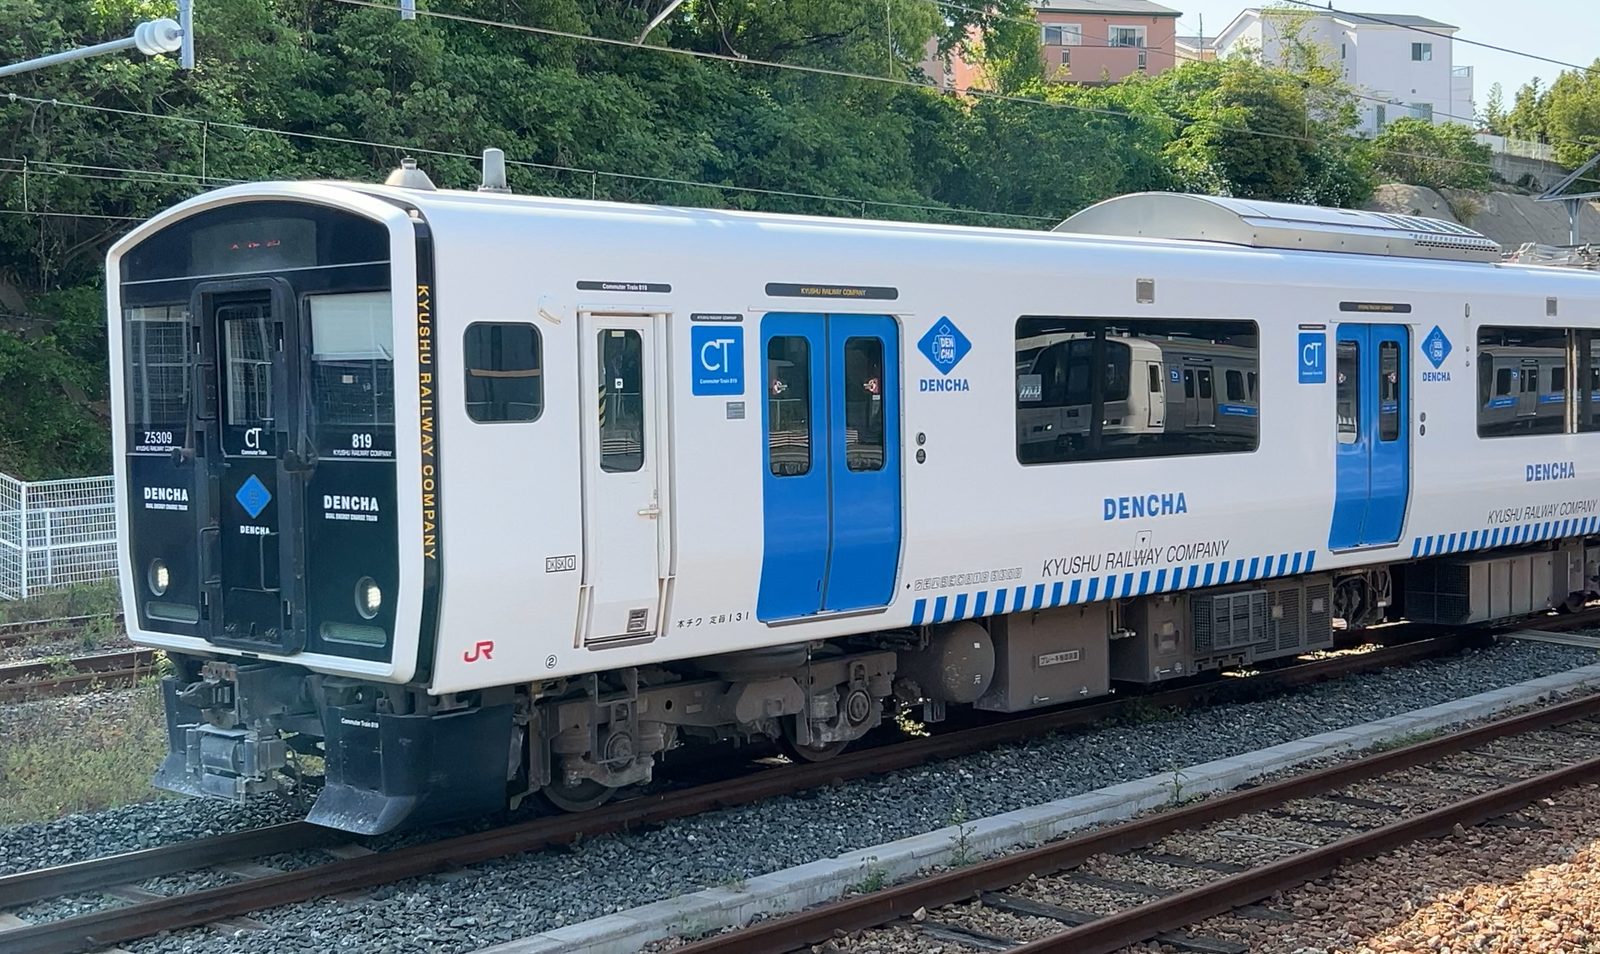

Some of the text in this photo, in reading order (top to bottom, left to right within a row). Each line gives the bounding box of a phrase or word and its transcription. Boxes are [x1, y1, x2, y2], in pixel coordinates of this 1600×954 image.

[701, 338, 735, 373] CT
[1303, 342, 1322, 368] CT
[919, 378, 970, 392] DENCHA
[1422, 371, 1451, 382] DENCHA
[418, 285, 436, 560] KYUSHU RAILWAY COMPANY
[144, 431, 173, 444] Z5309
[245, 427, 262, 449] CT
[352, 433, 372, 448] 819
[1526, 461, 1575, 482] DENCHA
[143, 486, 189, 502] DENCHA
[323, 494, 379, 512] DENCHA
[1103, 491, 1188, 521] DENCHA
[1487, 499, 1599, 525] KYUSHU RAILWAY COMPANY
[240, 525, 270, 535] DENCHA
[1042, 539, 1230, 578] KYUSHU RAILWAY COMPANY
[464, 640, 494, 662] JR
